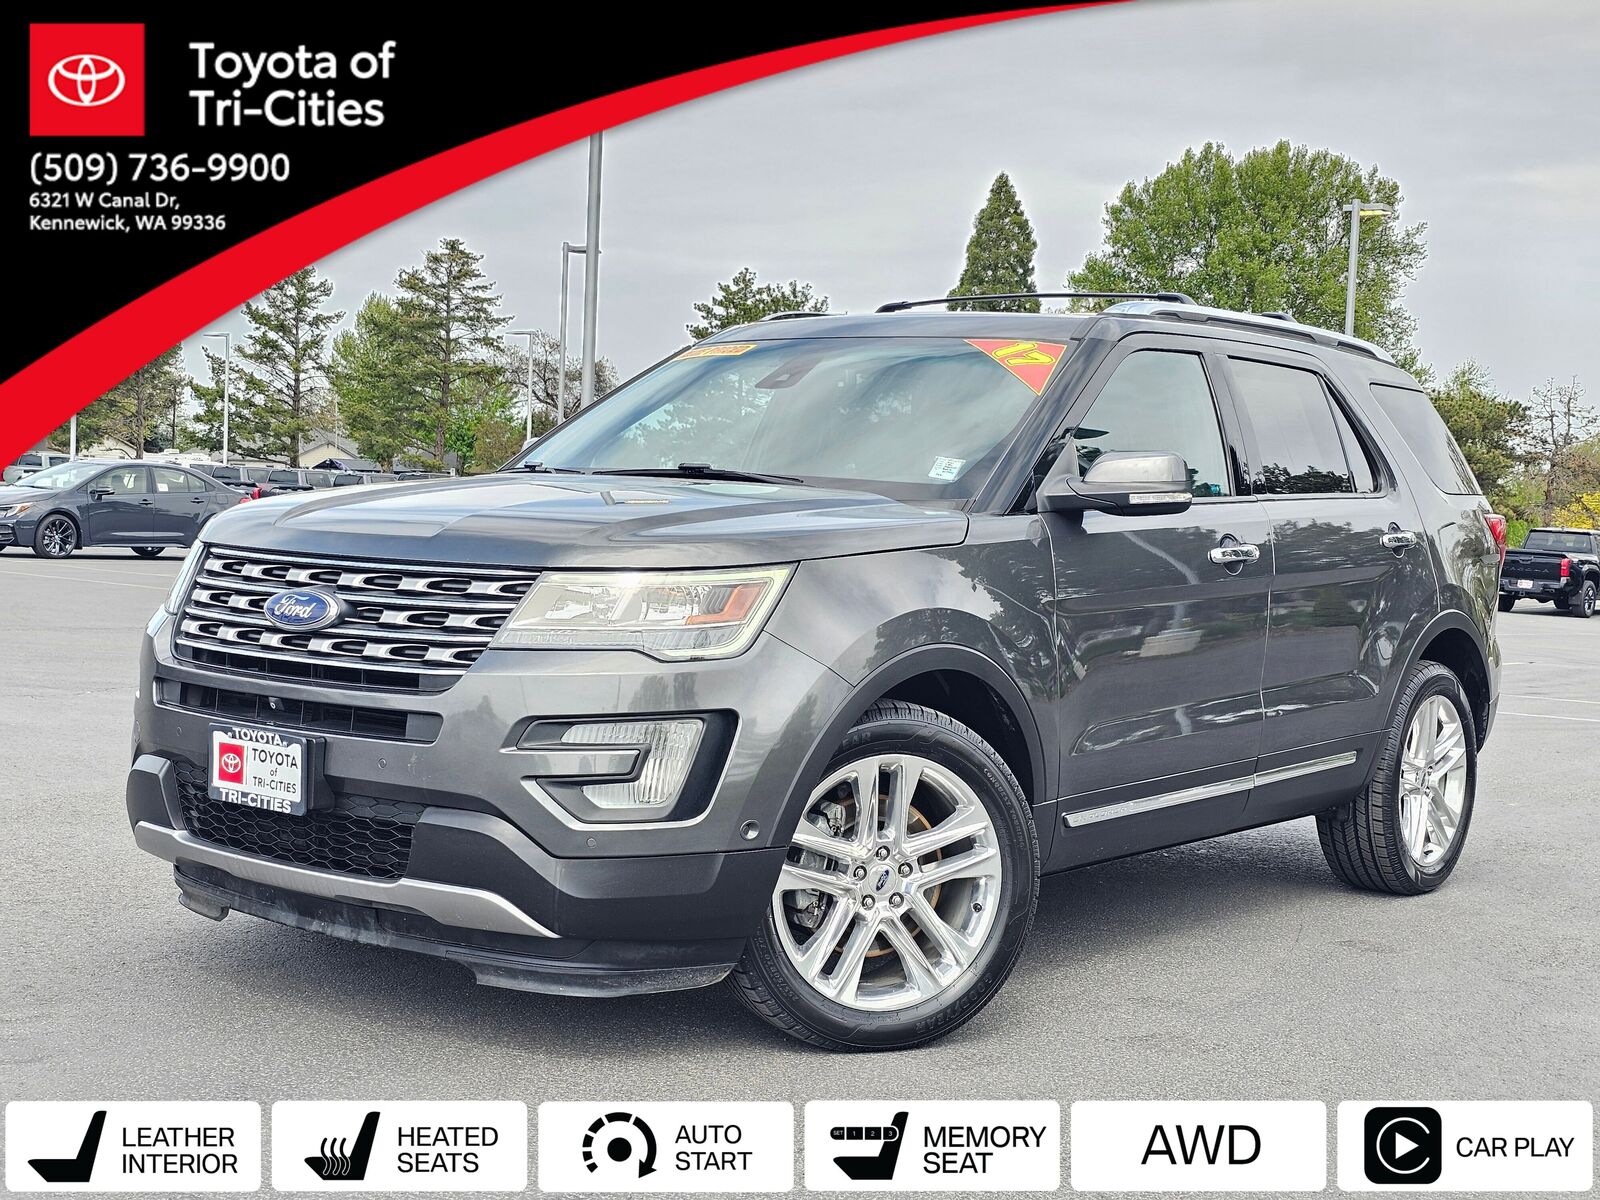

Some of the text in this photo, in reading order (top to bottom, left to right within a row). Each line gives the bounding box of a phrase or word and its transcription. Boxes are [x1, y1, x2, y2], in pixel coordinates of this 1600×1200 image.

[274, 594, 317, 618] Ford
[232, 727, 283, 746] TOYOTA
[252, 748, 298, 769] TOYOTA
[269, 768, 278, 777] of
[252, 776, 297, 794] TRI-CITIES
[220, 788, 292, 813] TRI-CITIES
